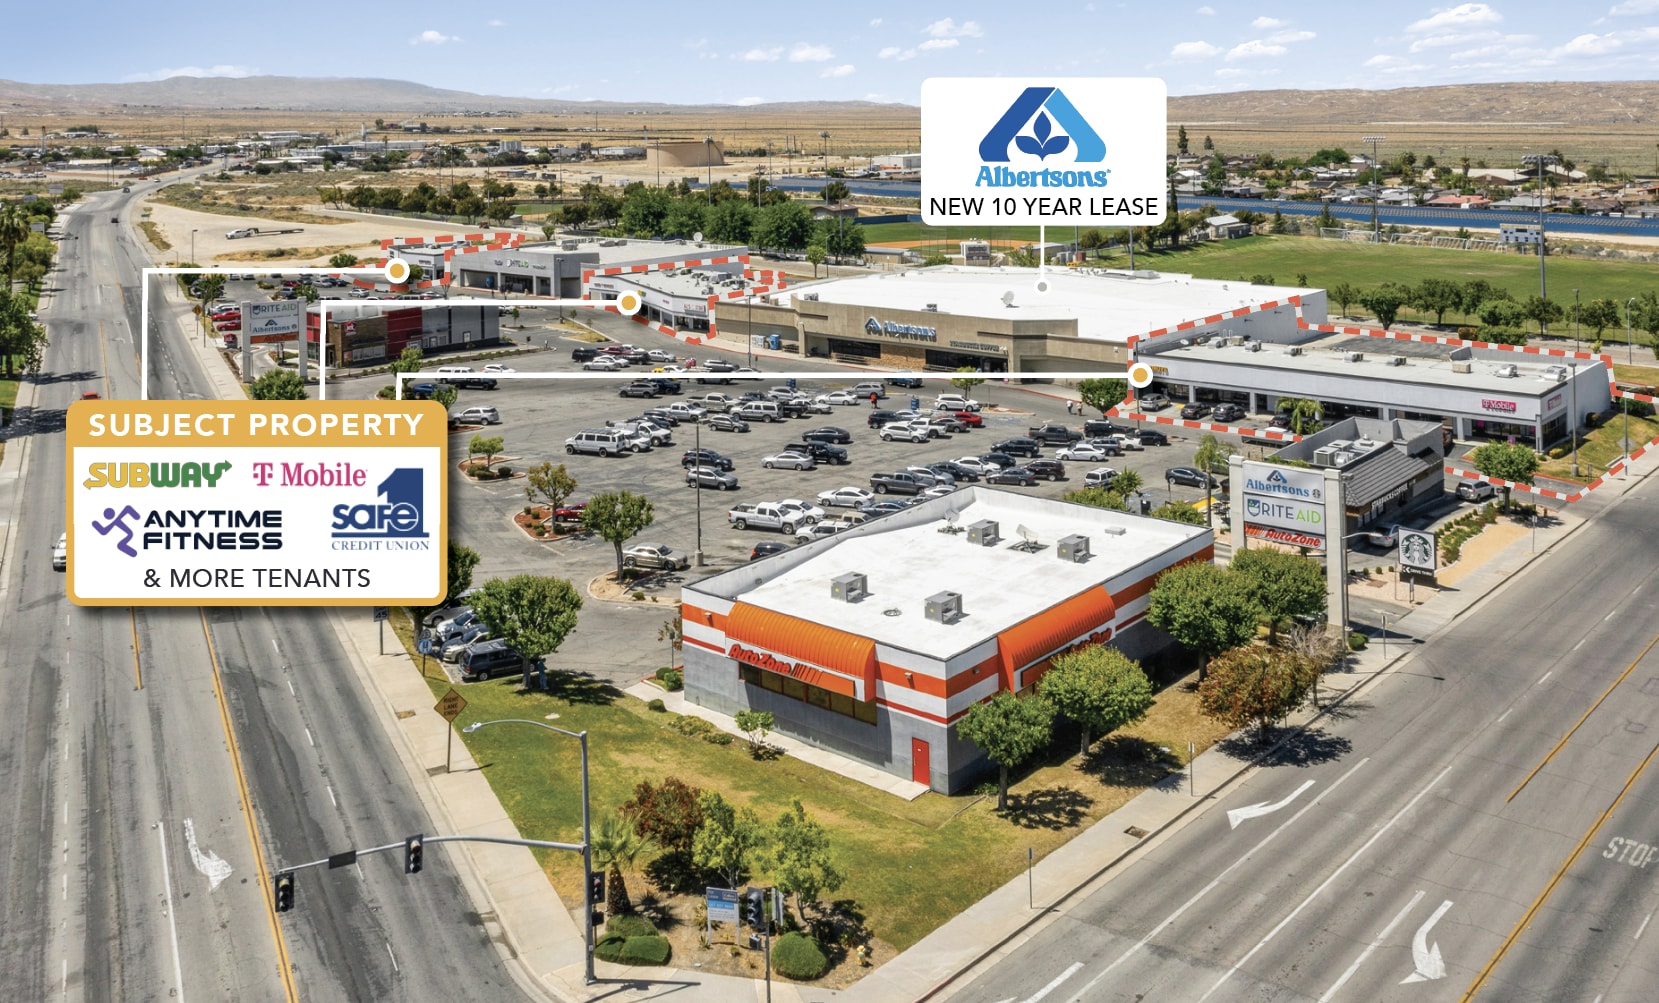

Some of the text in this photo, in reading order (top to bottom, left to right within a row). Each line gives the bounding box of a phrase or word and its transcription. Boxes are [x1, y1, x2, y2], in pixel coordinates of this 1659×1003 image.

[1246, 479, 1310, 497] Albertsons
[1262, 502, 1321, 524] RITE AID
[1265, 528, 1321, 547] AutoZone
[728, 644, 792, 675] AutoZone
